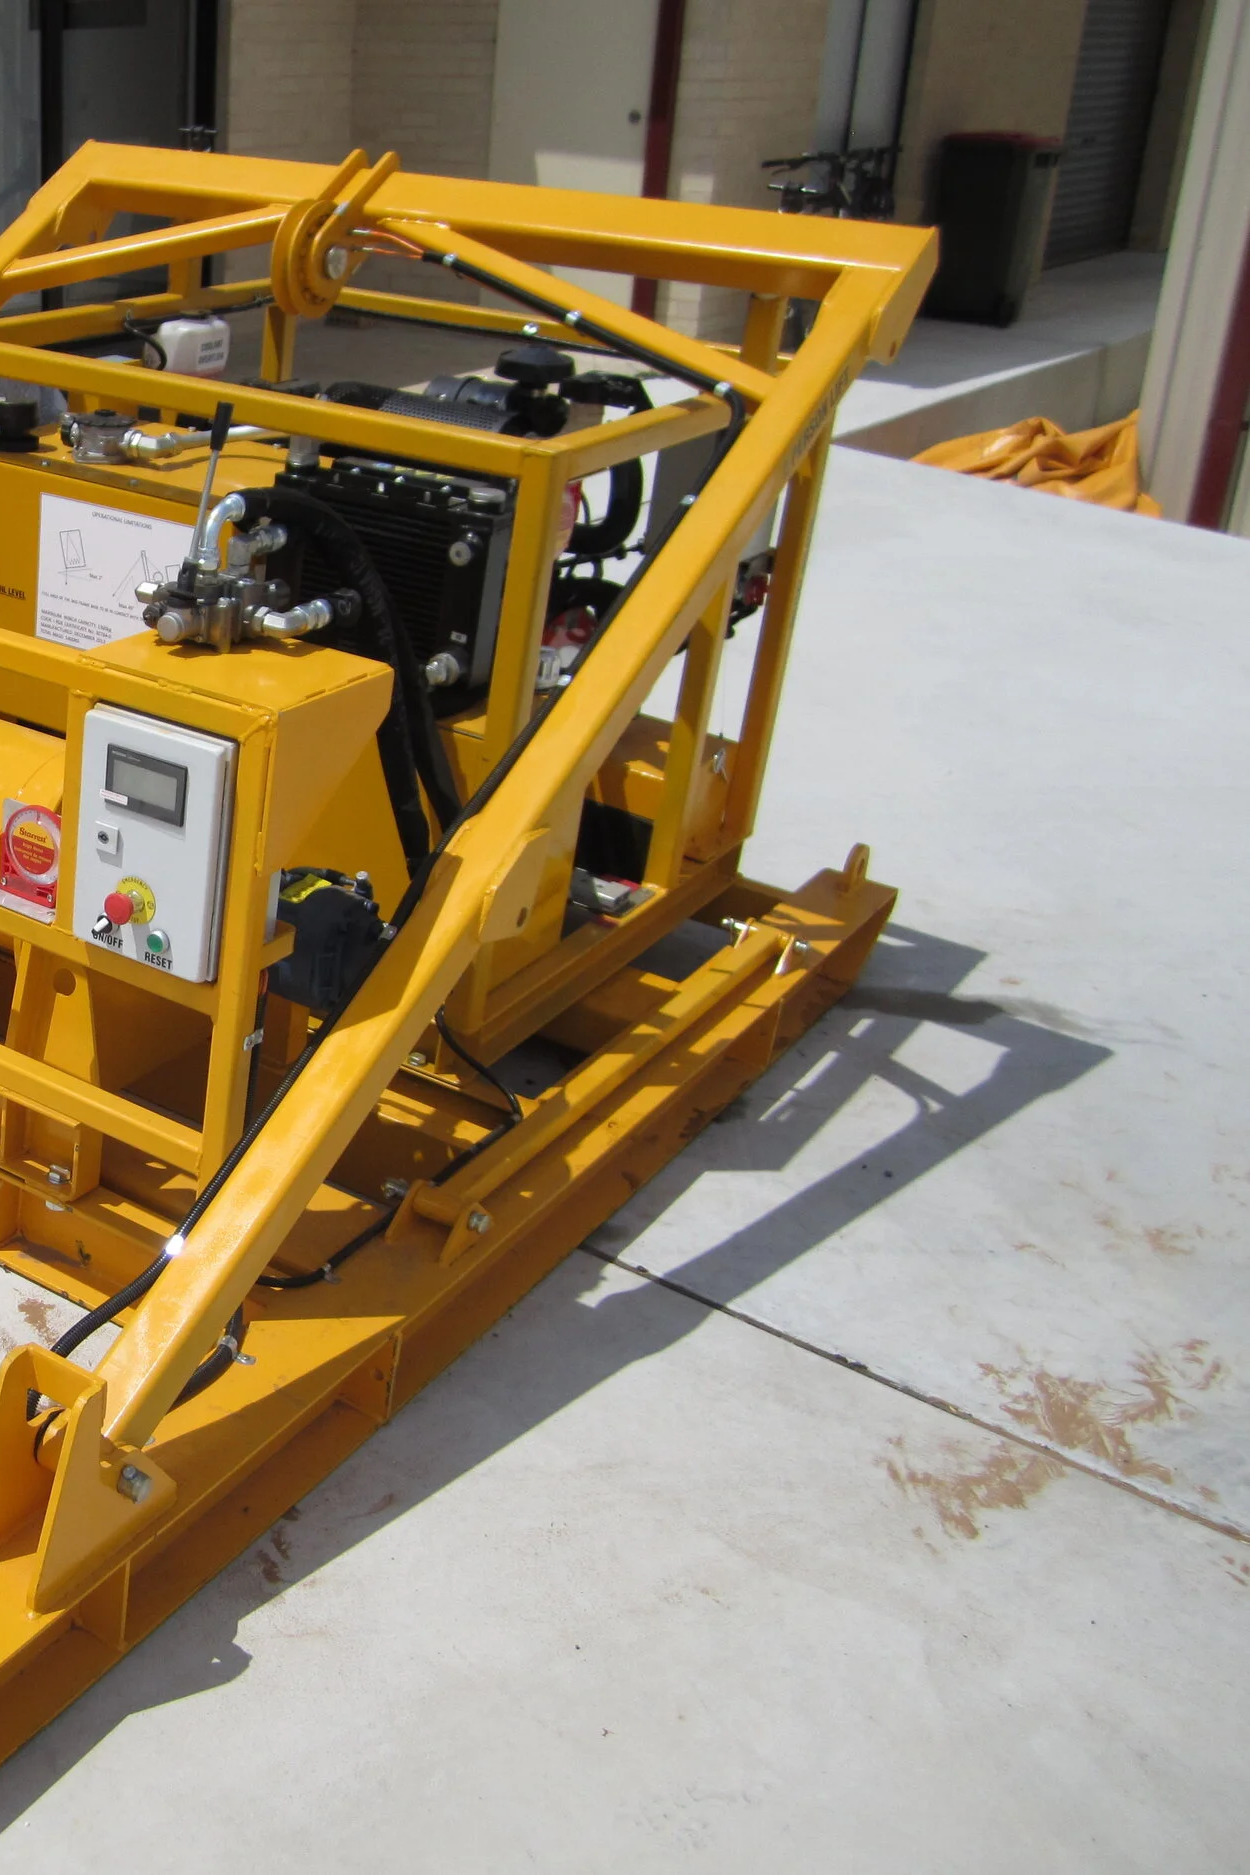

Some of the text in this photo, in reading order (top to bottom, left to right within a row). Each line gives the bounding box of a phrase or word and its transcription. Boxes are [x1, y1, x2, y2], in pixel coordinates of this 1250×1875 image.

[8, 587, 26, 600] LEVEL
[19, 827, 47, 844] Starrett
[92, 932, 124, 949] ON/OFF
[144, 951, 173, 970] RESET
